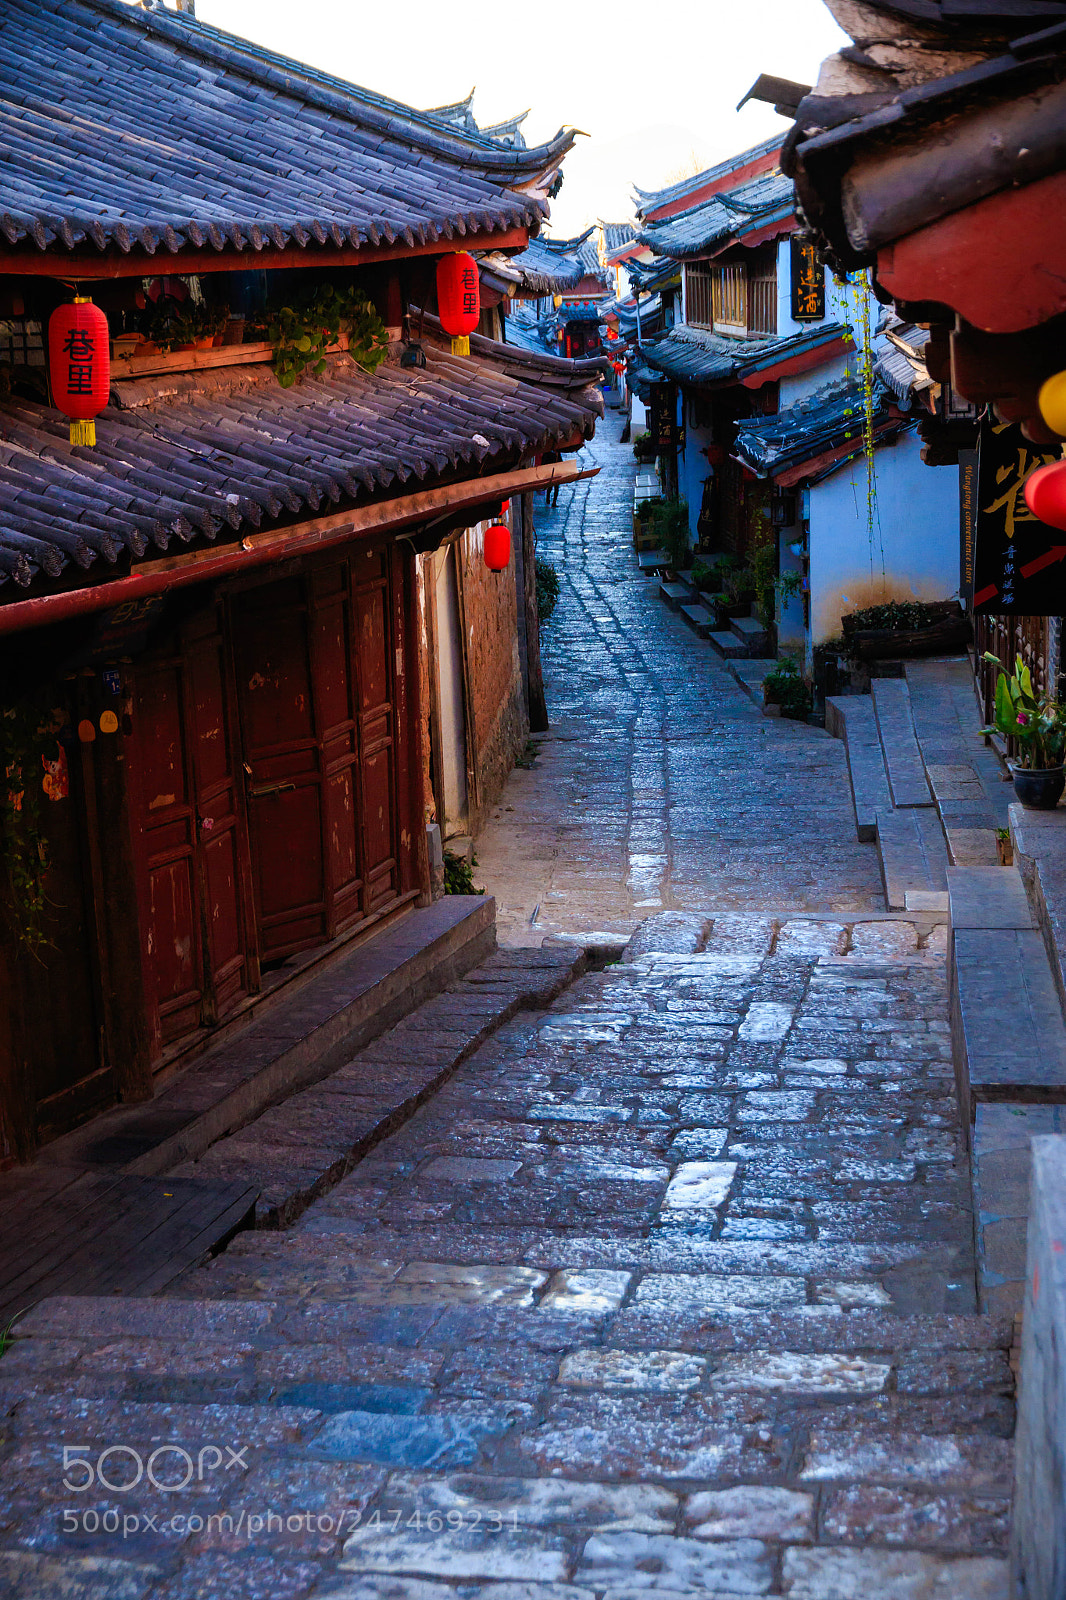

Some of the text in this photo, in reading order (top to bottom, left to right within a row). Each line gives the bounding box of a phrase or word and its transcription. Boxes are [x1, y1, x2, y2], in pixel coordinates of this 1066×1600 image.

[462, 268, 478, 314] 巷里
[62, 328, 96, 396] 巷里
[961, 464, 974, 584] Wangtong convenience store
